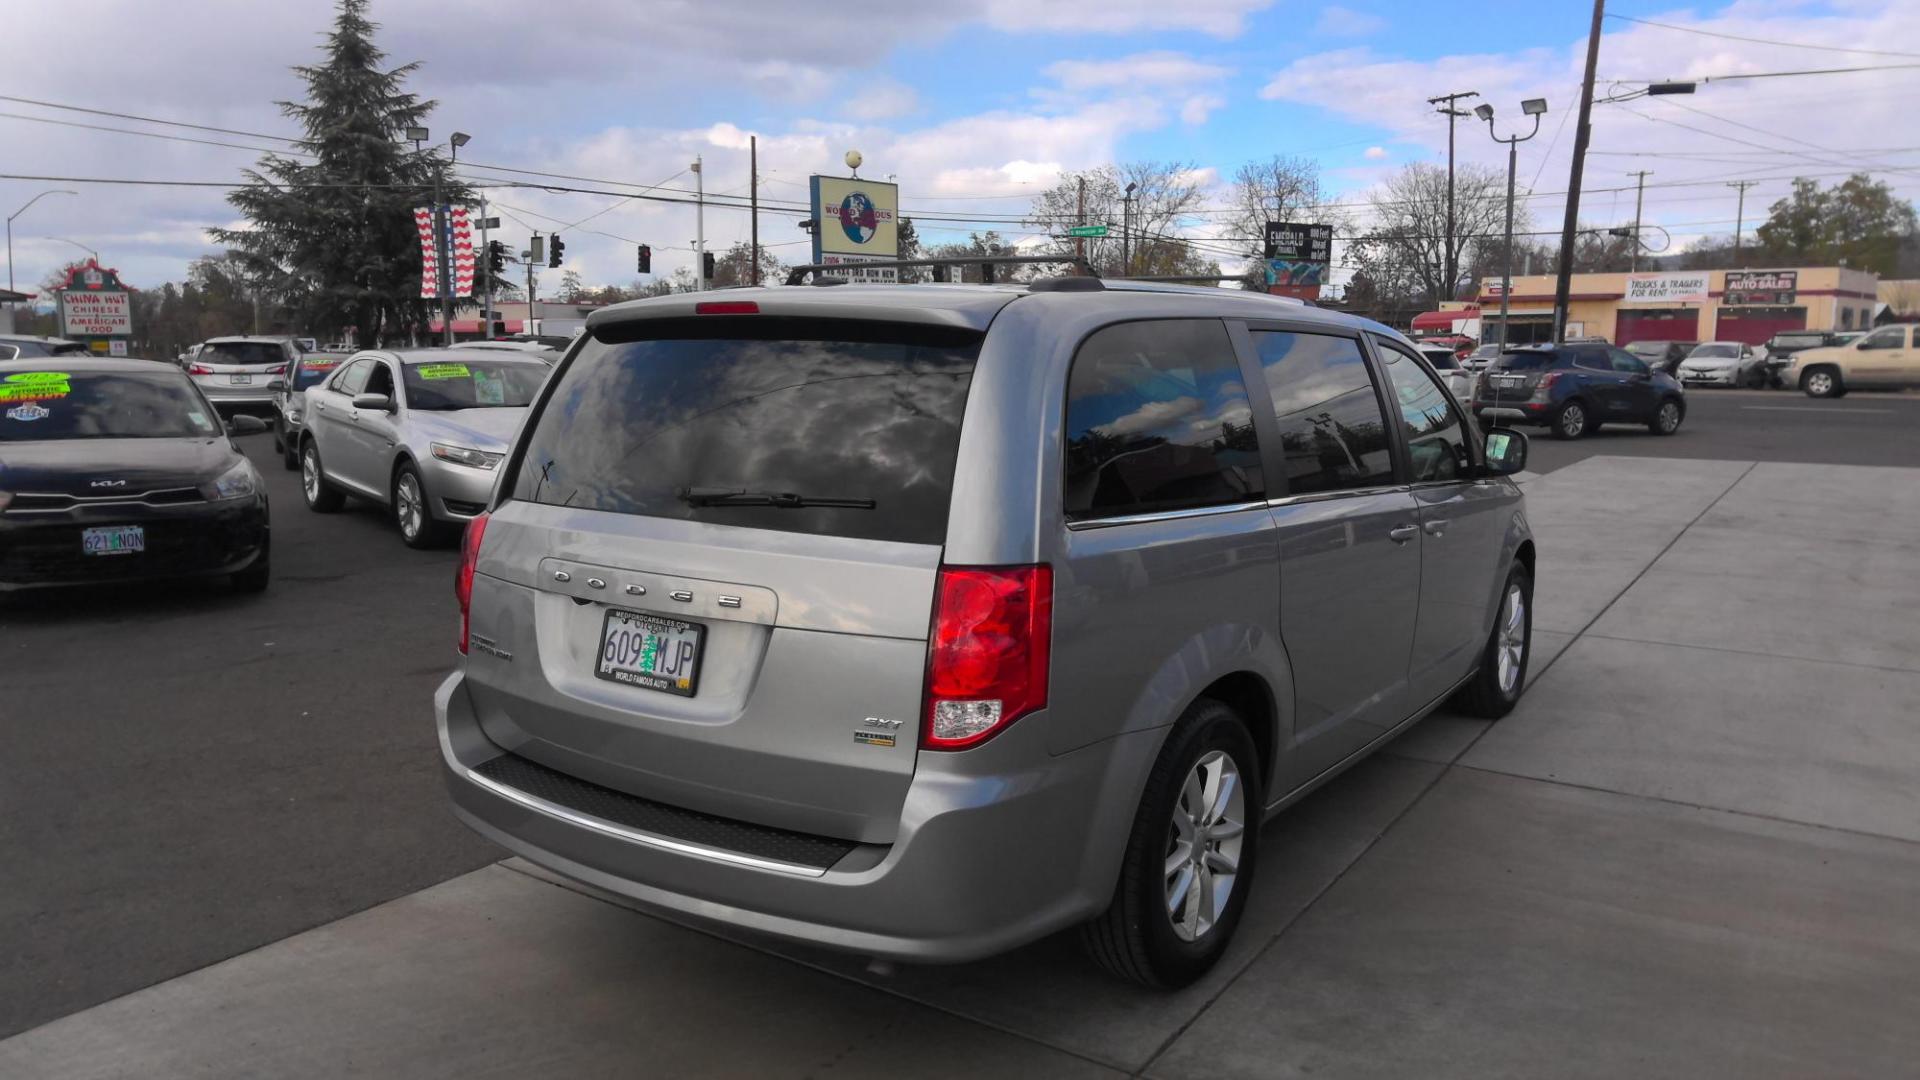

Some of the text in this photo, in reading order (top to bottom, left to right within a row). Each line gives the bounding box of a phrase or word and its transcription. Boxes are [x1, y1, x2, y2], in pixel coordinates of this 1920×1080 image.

[1270, 231, 1304, 247] EMERALD
[1631, 280, 1657, 289] TRUCKS
[1729, 280, 1792, 289] AUTO SALES
[64, 294, 126, 305] CHINA HUT
[1631, 289, 1646, 297] FOR
[1648, 289, 1668, 297] RENT
[70, 317, 125, 326] AMERICAN
[85, 535, 107, 550] 621
[555, 570, 742, 608] DODGE
[616, 610, 690, 630] MEDFORDCARSALES.COM
[604, 630, 694, 676] 609 MJP
[615, 671, 668, 689] WORLD FAMOUS AUTO
[864, 717, 905, 729] SXT
